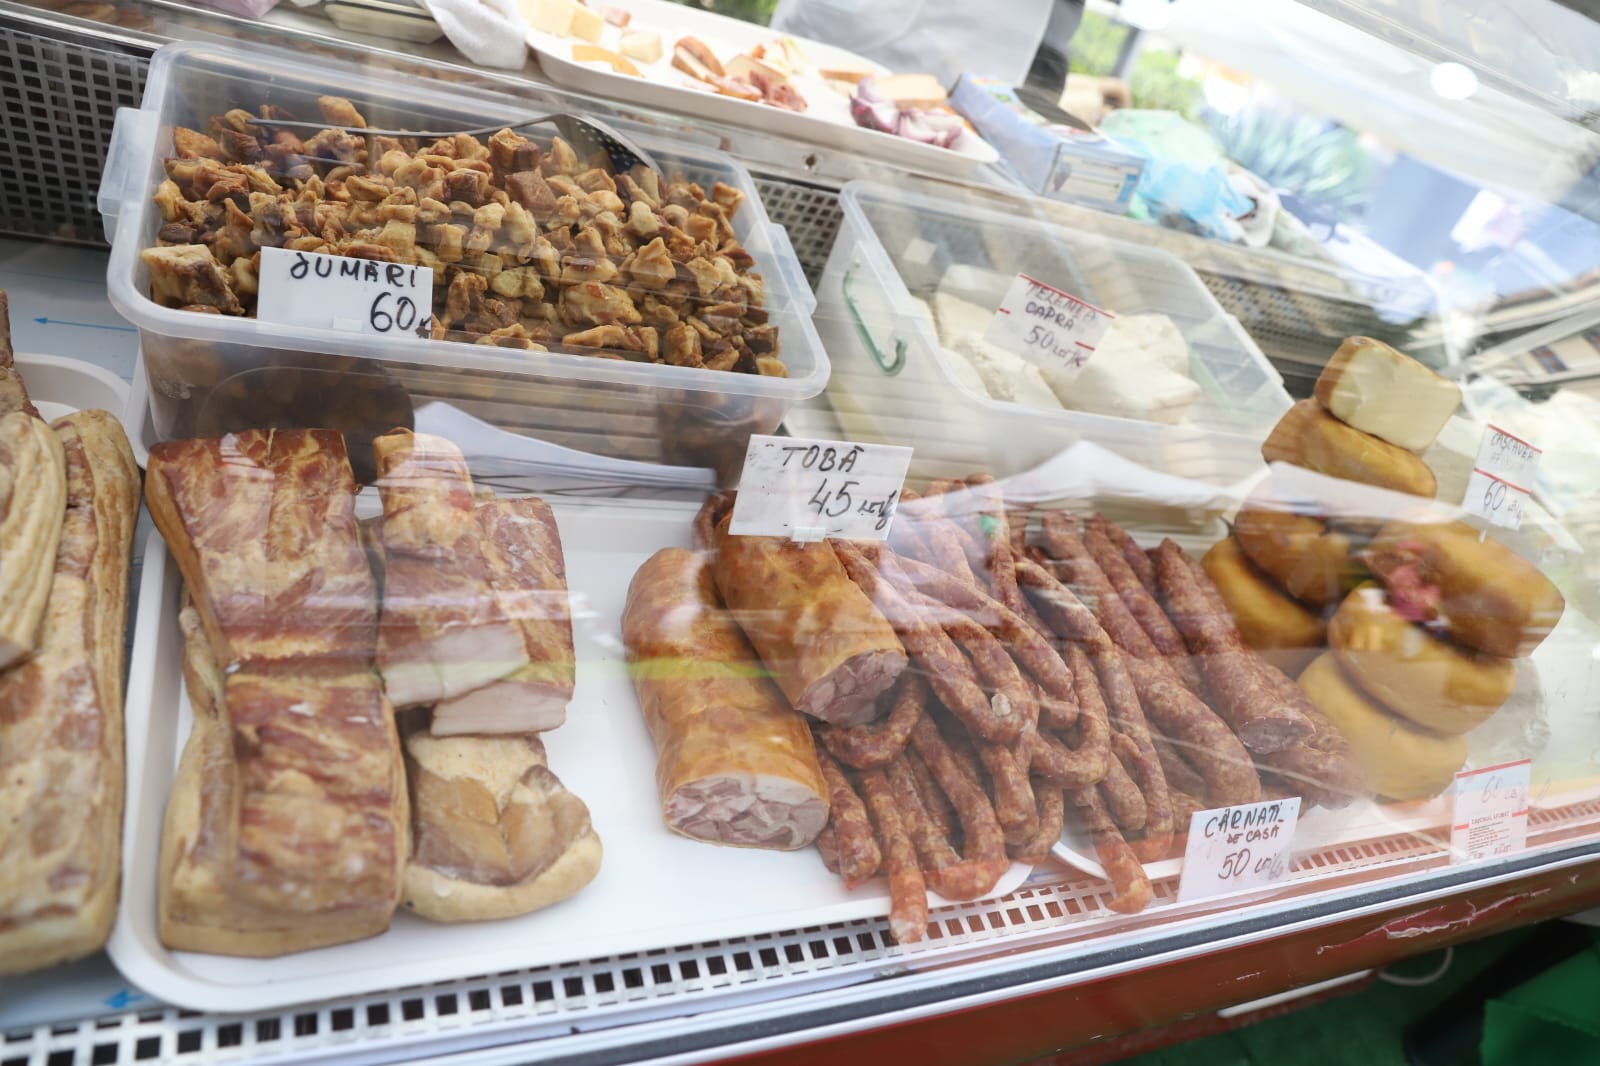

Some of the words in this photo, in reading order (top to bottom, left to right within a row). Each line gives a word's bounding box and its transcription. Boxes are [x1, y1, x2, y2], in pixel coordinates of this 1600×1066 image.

[370, 291, 417, 332] 60
[1023, 324, 1055, 349] 50
[807, 478, 860, 518] 45
[1483, 479, 1507, 511] 60
[1217, 848, 1251, 880] 50
